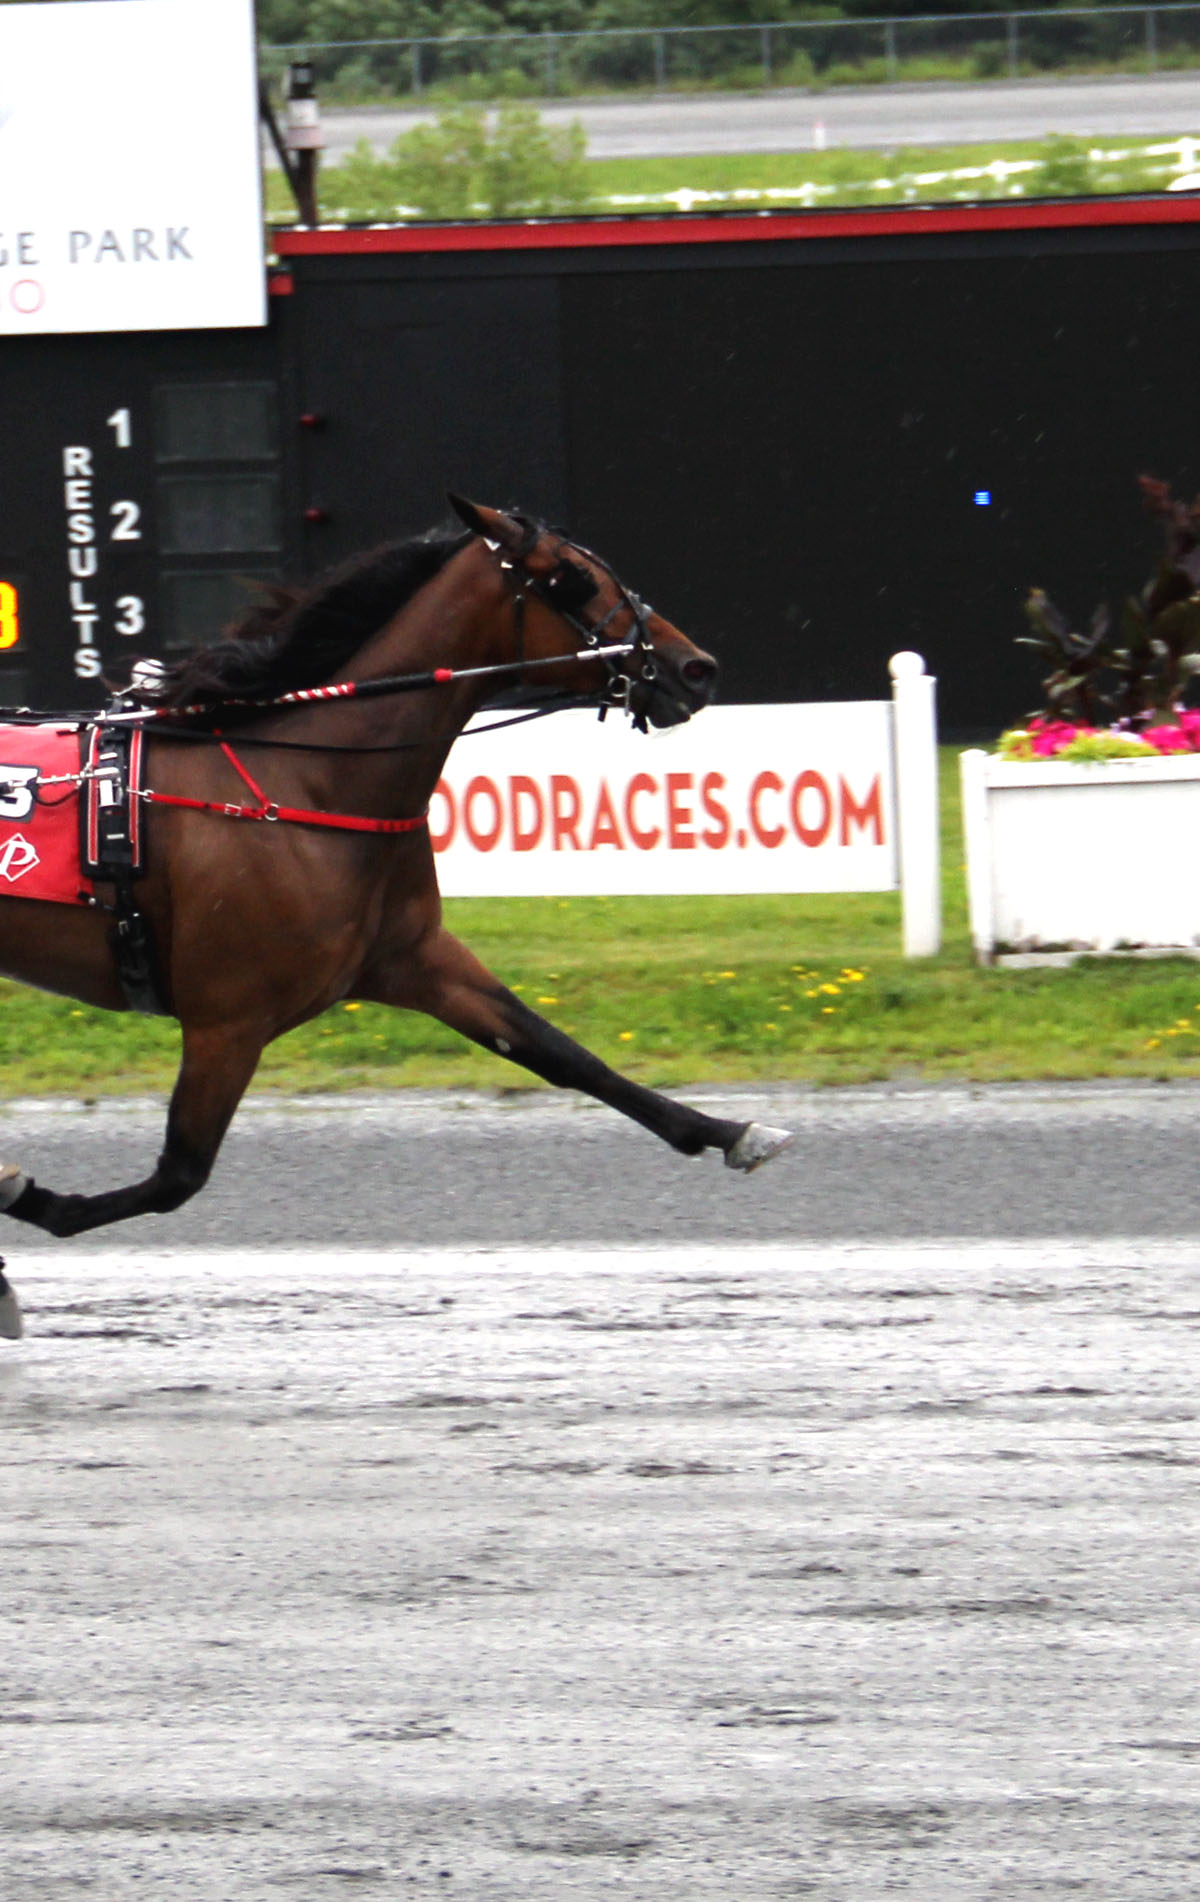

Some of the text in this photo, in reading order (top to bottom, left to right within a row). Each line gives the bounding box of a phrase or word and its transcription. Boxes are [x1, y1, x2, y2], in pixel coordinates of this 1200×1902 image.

[70, 227, 194, 264] PARK
[108, 409, 132, 448] 1
[112, 501, 142, 542] 2
[63, 447, 103, 679] RESULTS
[116, 596, 146, 637] 3
